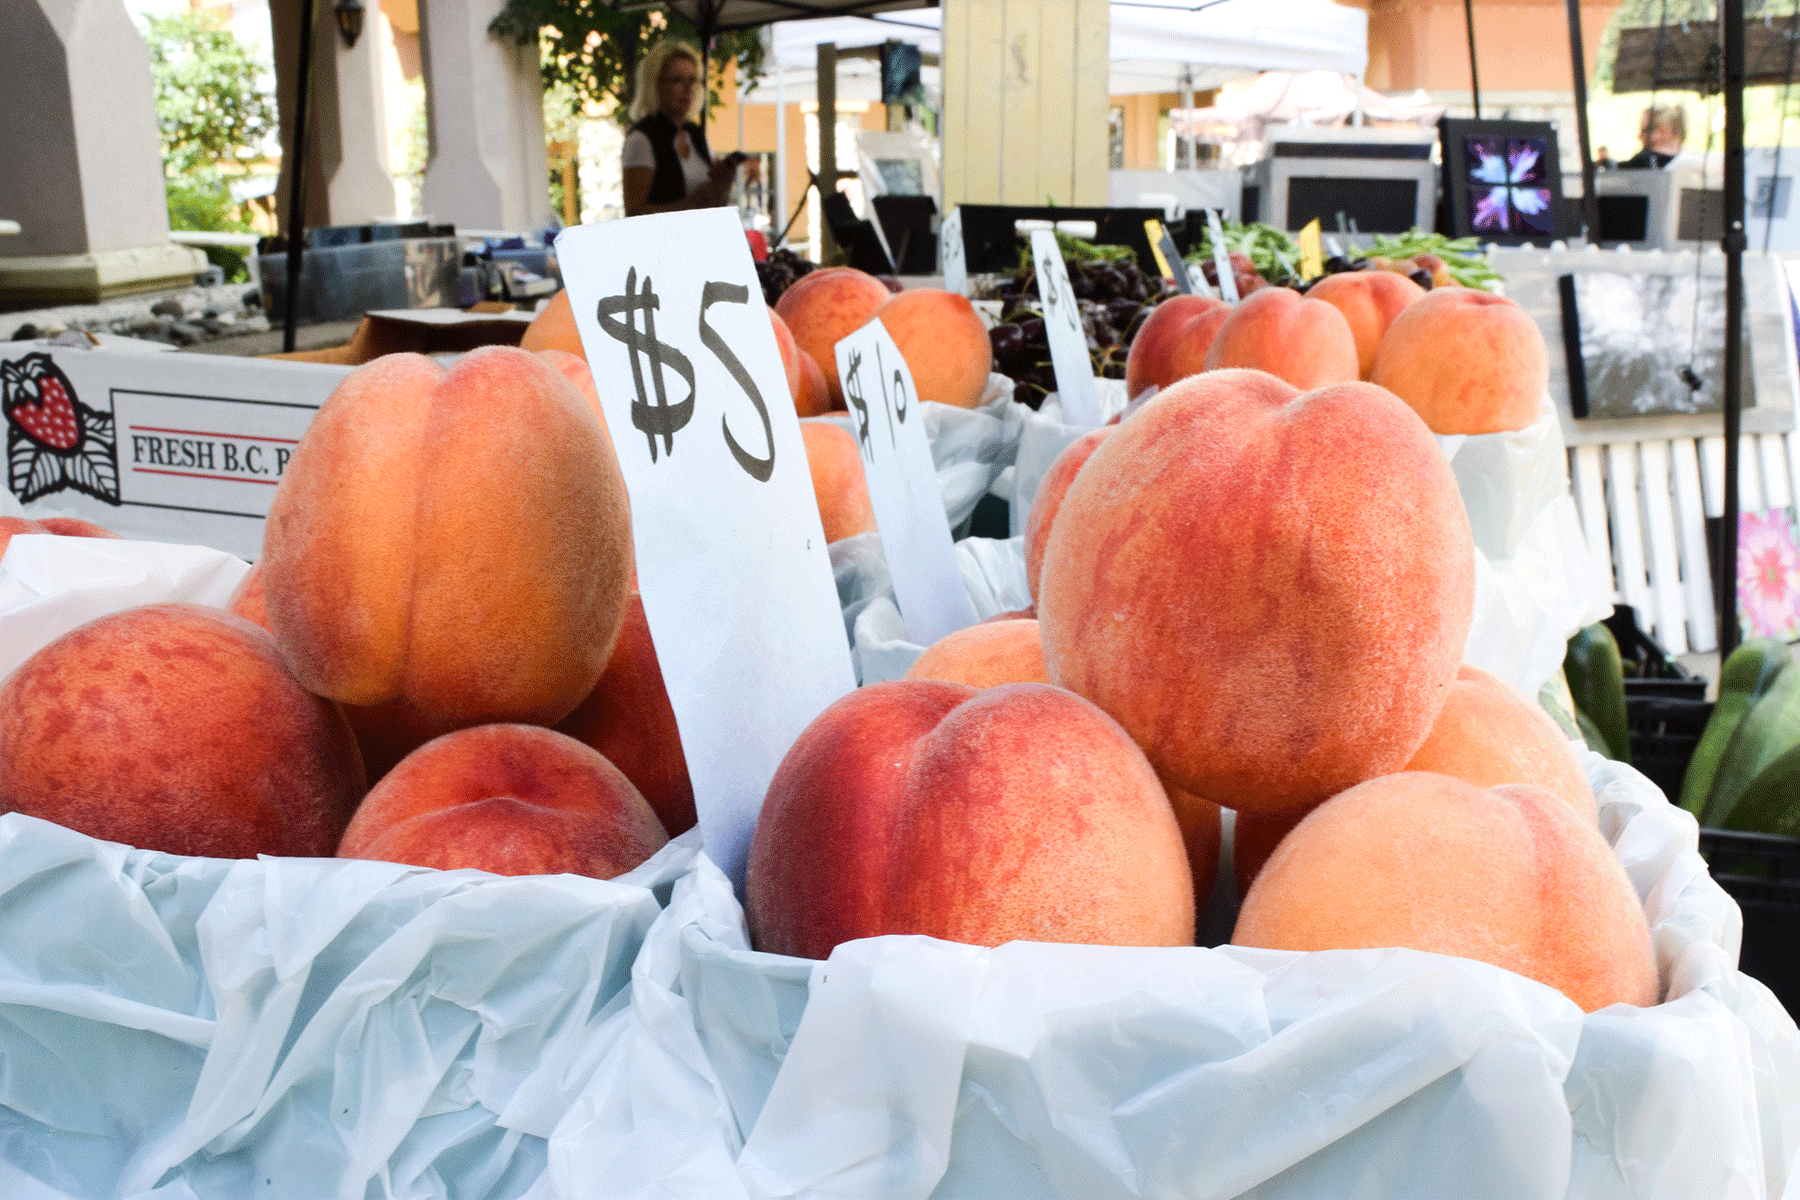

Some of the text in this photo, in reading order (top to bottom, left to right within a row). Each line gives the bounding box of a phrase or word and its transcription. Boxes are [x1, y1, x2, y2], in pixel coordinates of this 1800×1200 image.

[597, 266, 775, 483] $5
[846, 340, 907, 465] $10
[131, 435, 216, 471] FRESH
[223, 443, 268, 474] B.C.
